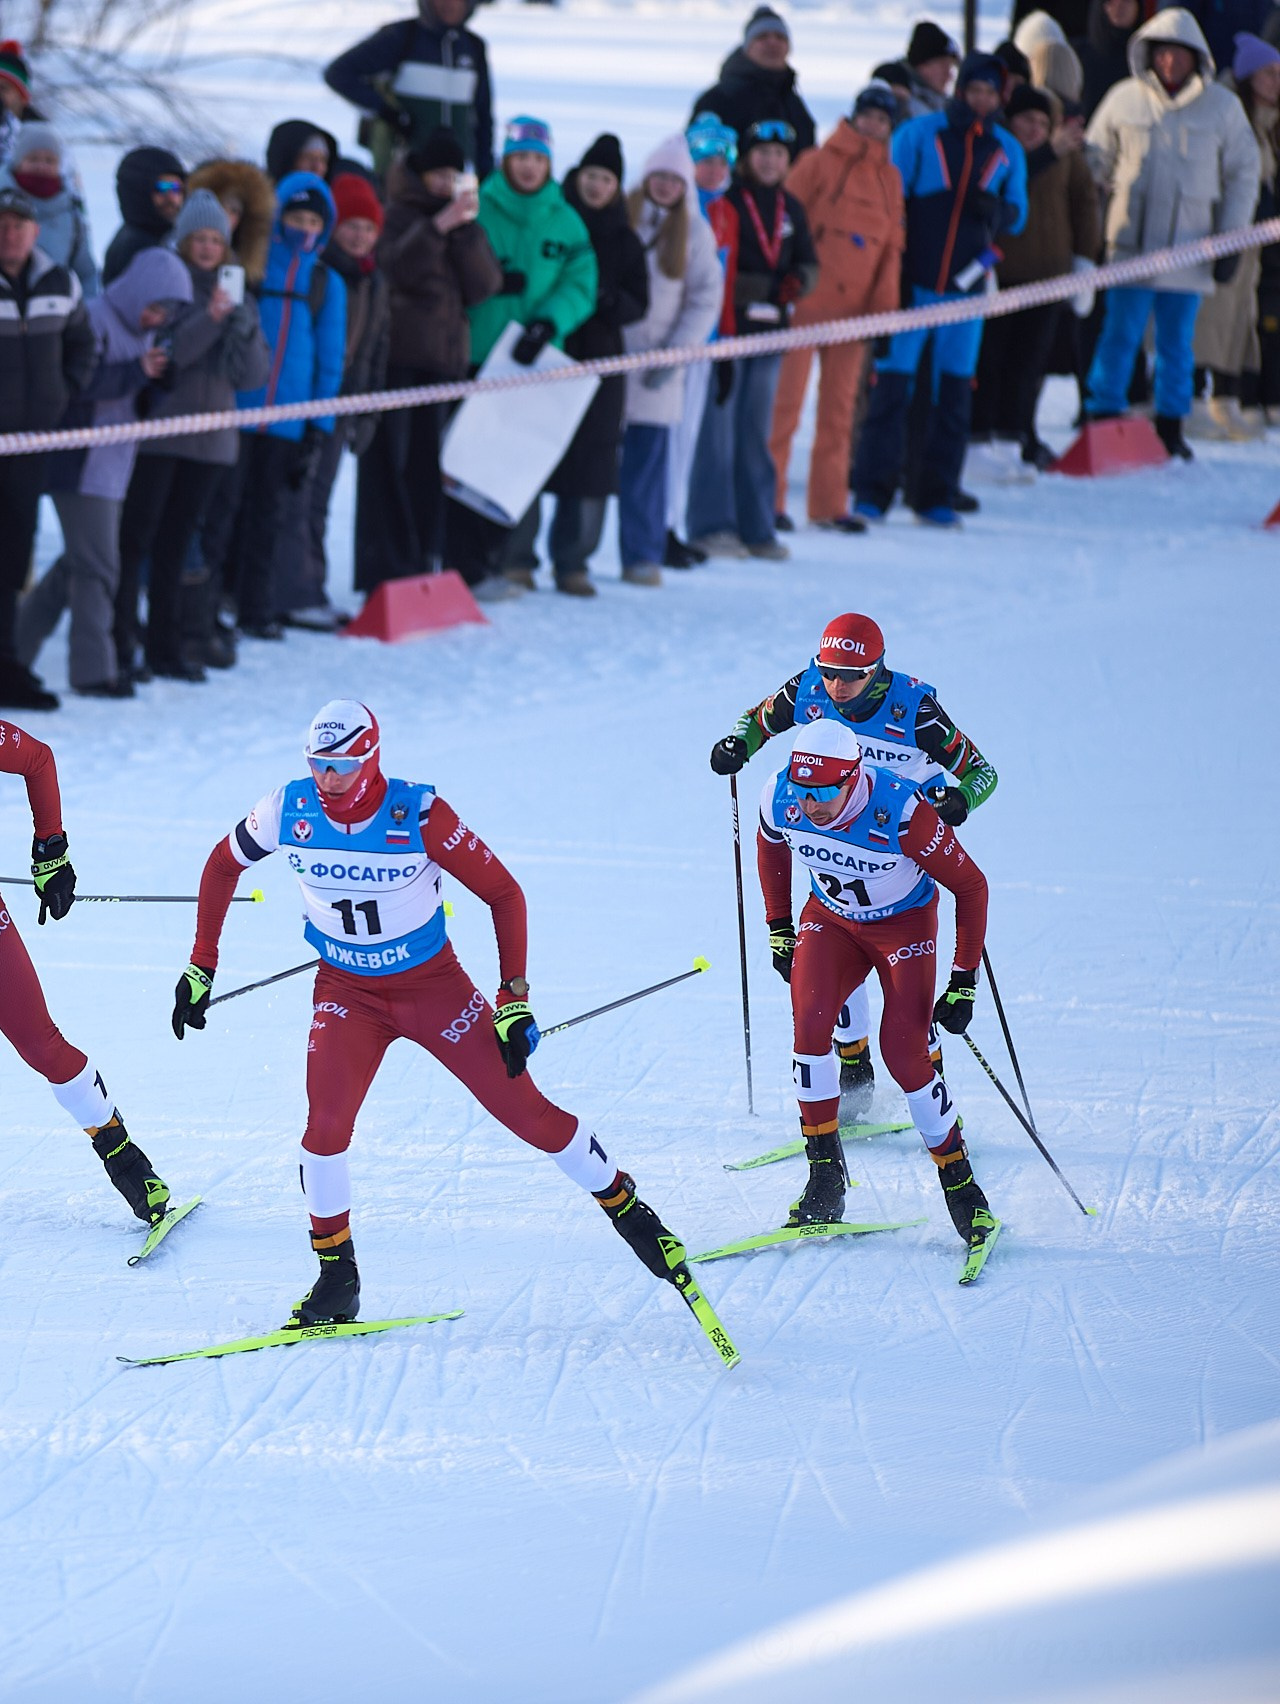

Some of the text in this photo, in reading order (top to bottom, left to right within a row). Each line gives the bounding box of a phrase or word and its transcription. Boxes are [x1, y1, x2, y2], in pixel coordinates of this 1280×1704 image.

[314, 721, 347, 731] LUKOIL
[793, 754, 824, 767] LUKOIL
[310, 864, 418, 882] ФОСАГРО
[798, 843, 898, 874] ФОСАГРО
[817, 872, 872, 908] 21
[331, 899, 382, 936] 11
[324, 940, 411, 970] ИЖЕВСК
[886, 939, 936, 967] BOSCO
[440, 989, 486, 1044] BOSCO
[93, 1069, 108, 1100] 1
[932, 1081, 954, 1117] 2
[799, 1225, 829, 1237] FISCHER
[301, 1325, 338, 1338] FISCHER
[708, 1325, 736, 1361] FISCHER
